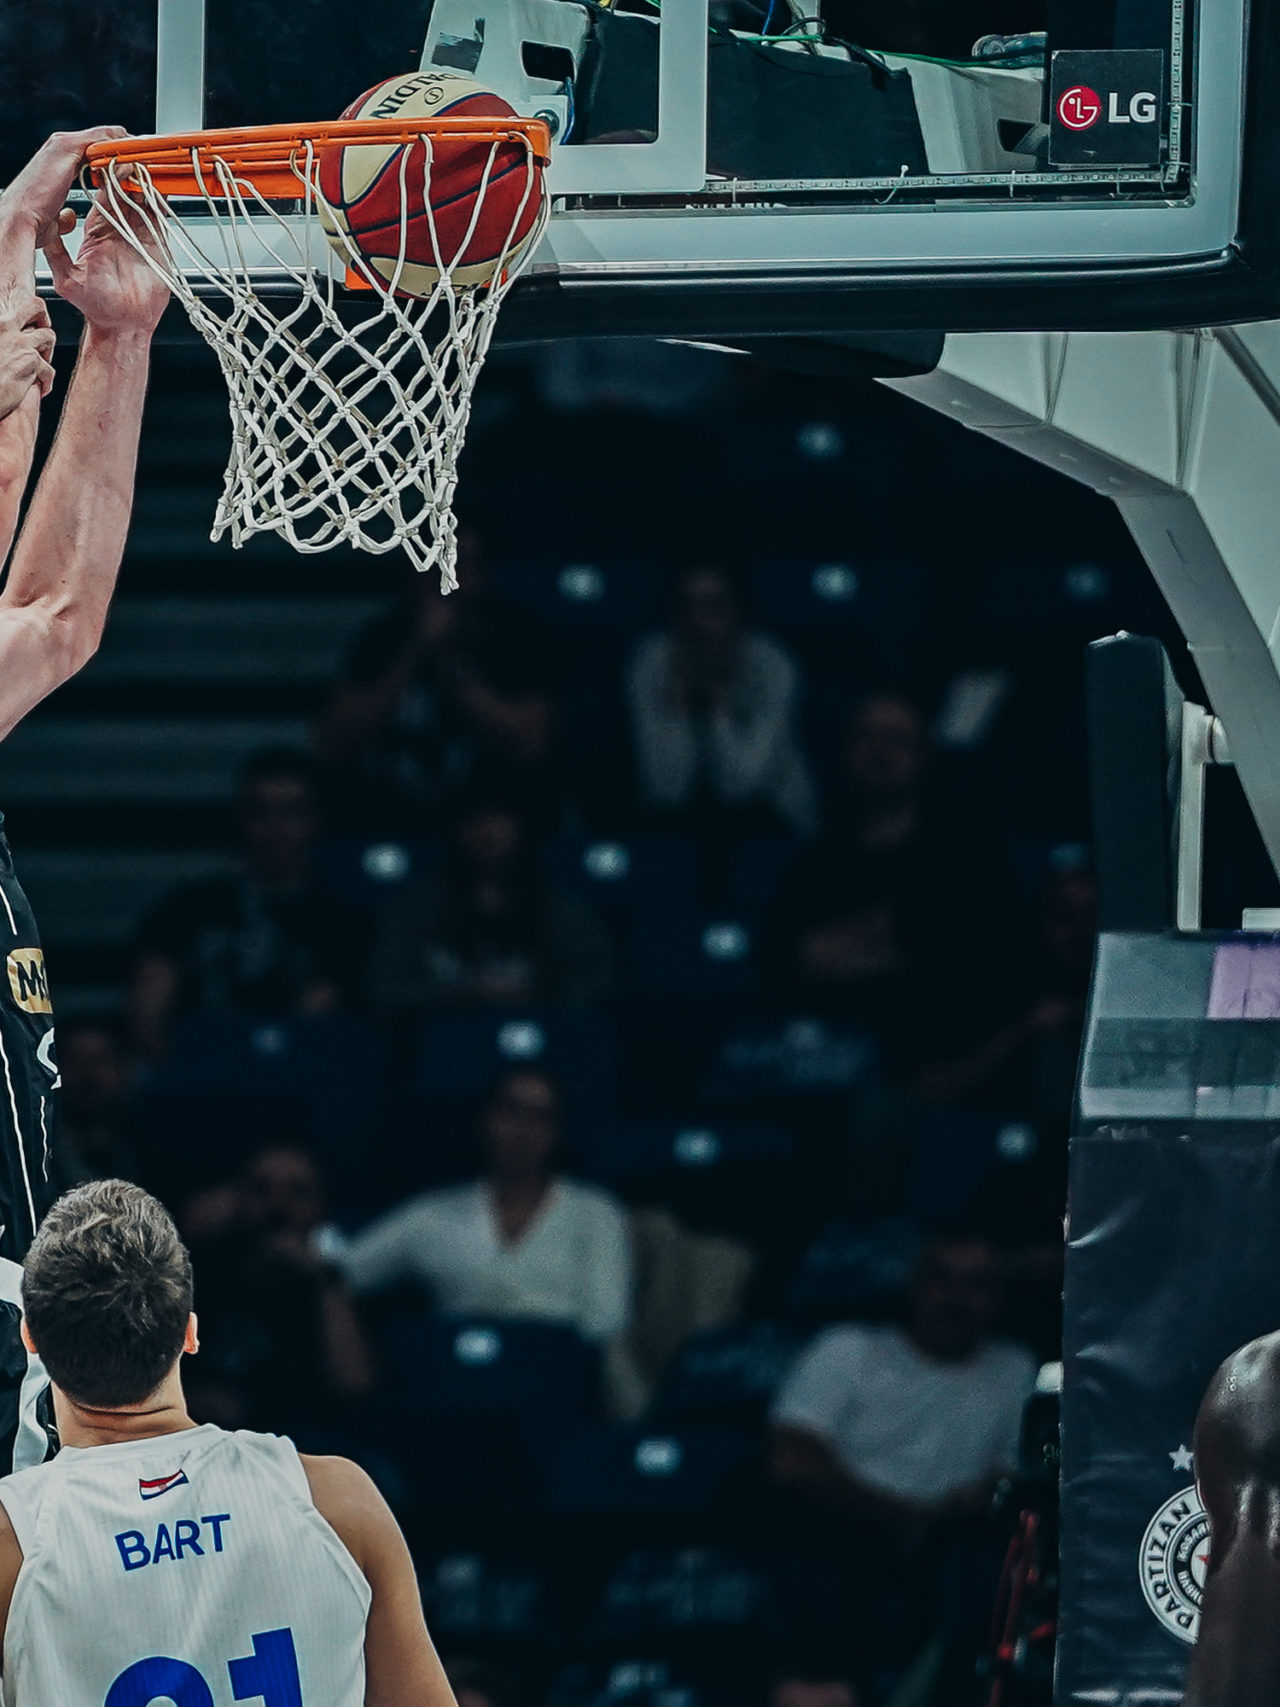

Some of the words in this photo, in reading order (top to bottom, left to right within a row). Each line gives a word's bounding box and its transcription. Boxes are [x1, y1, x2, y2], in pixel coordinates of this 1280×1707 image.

[1108, 92, 1156, 123] LG
[115, 1513, 231, 1572] BART
[1147, 1500, 1193, 1629] PARTIZAN
